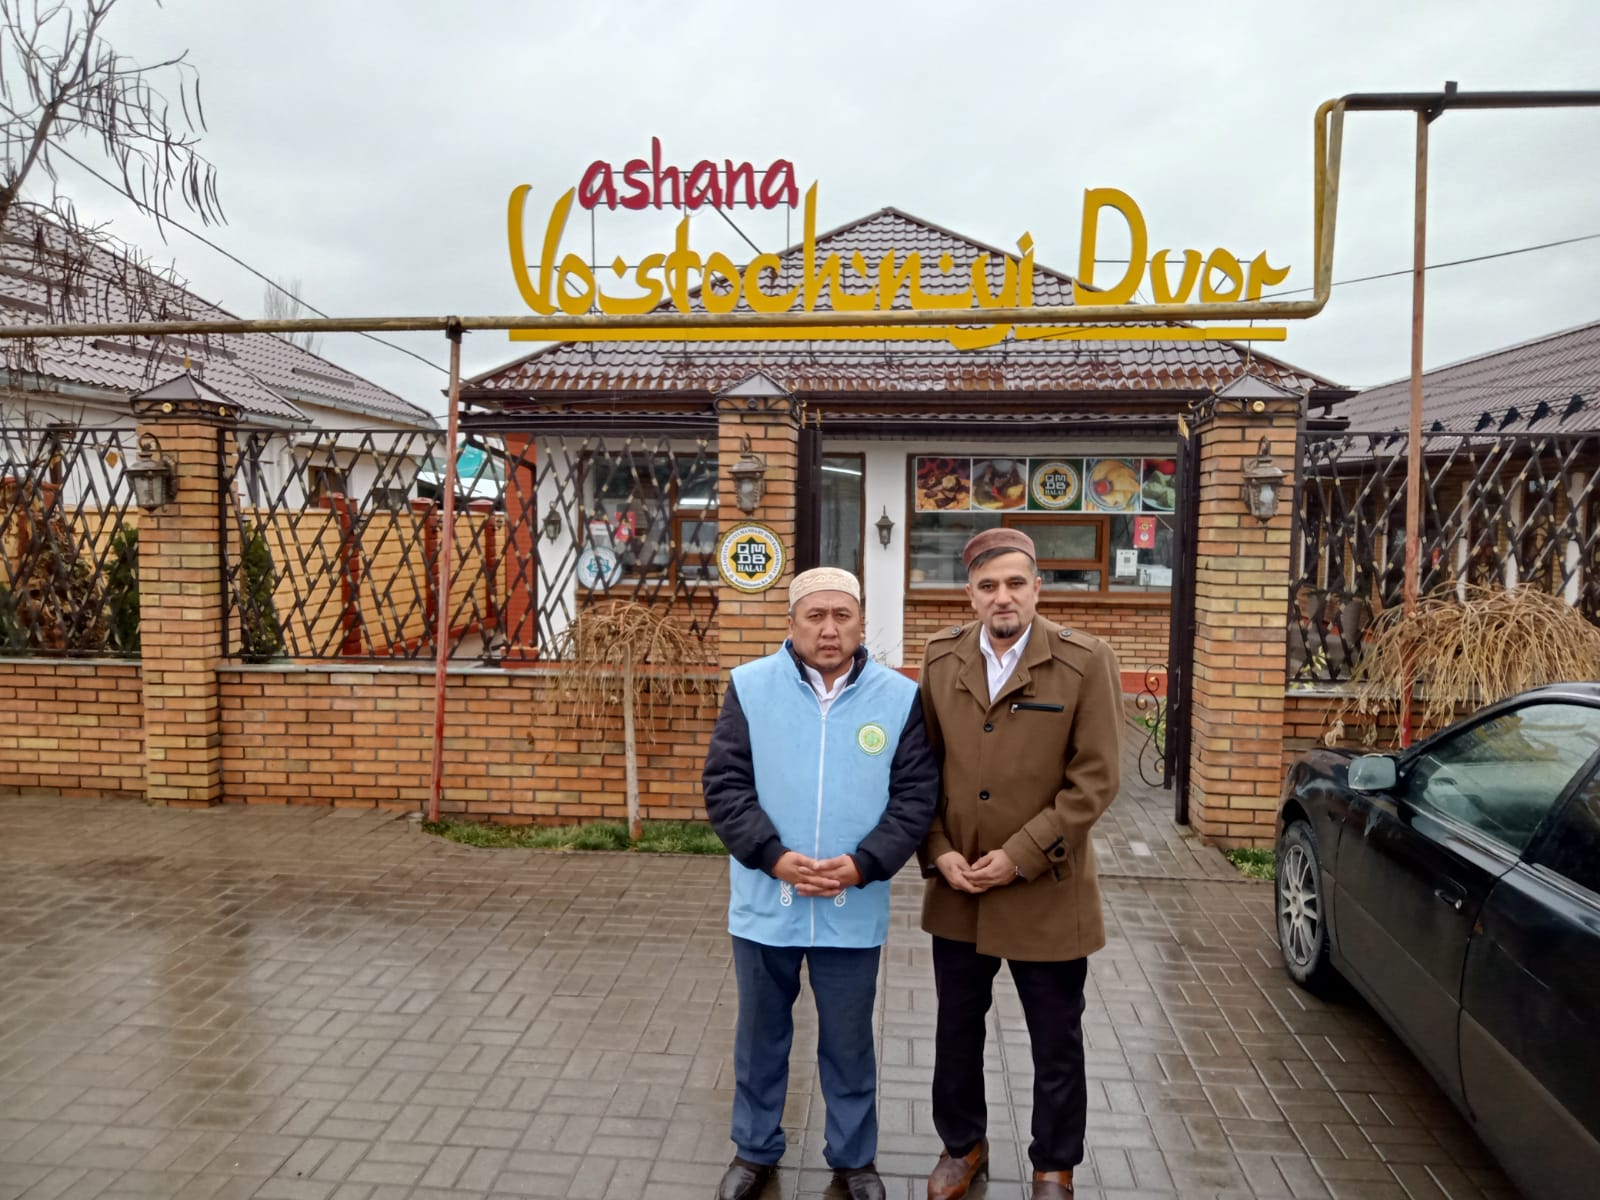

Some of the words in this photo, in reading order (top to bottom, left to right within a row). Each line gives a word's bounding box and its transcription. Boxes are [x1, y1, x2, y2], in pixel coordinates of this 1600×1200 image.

[578, 136, 799, 210] ashana
[1072, 187, 1291, 306] Dvor
[737, 564, 765, 572] HALAL
